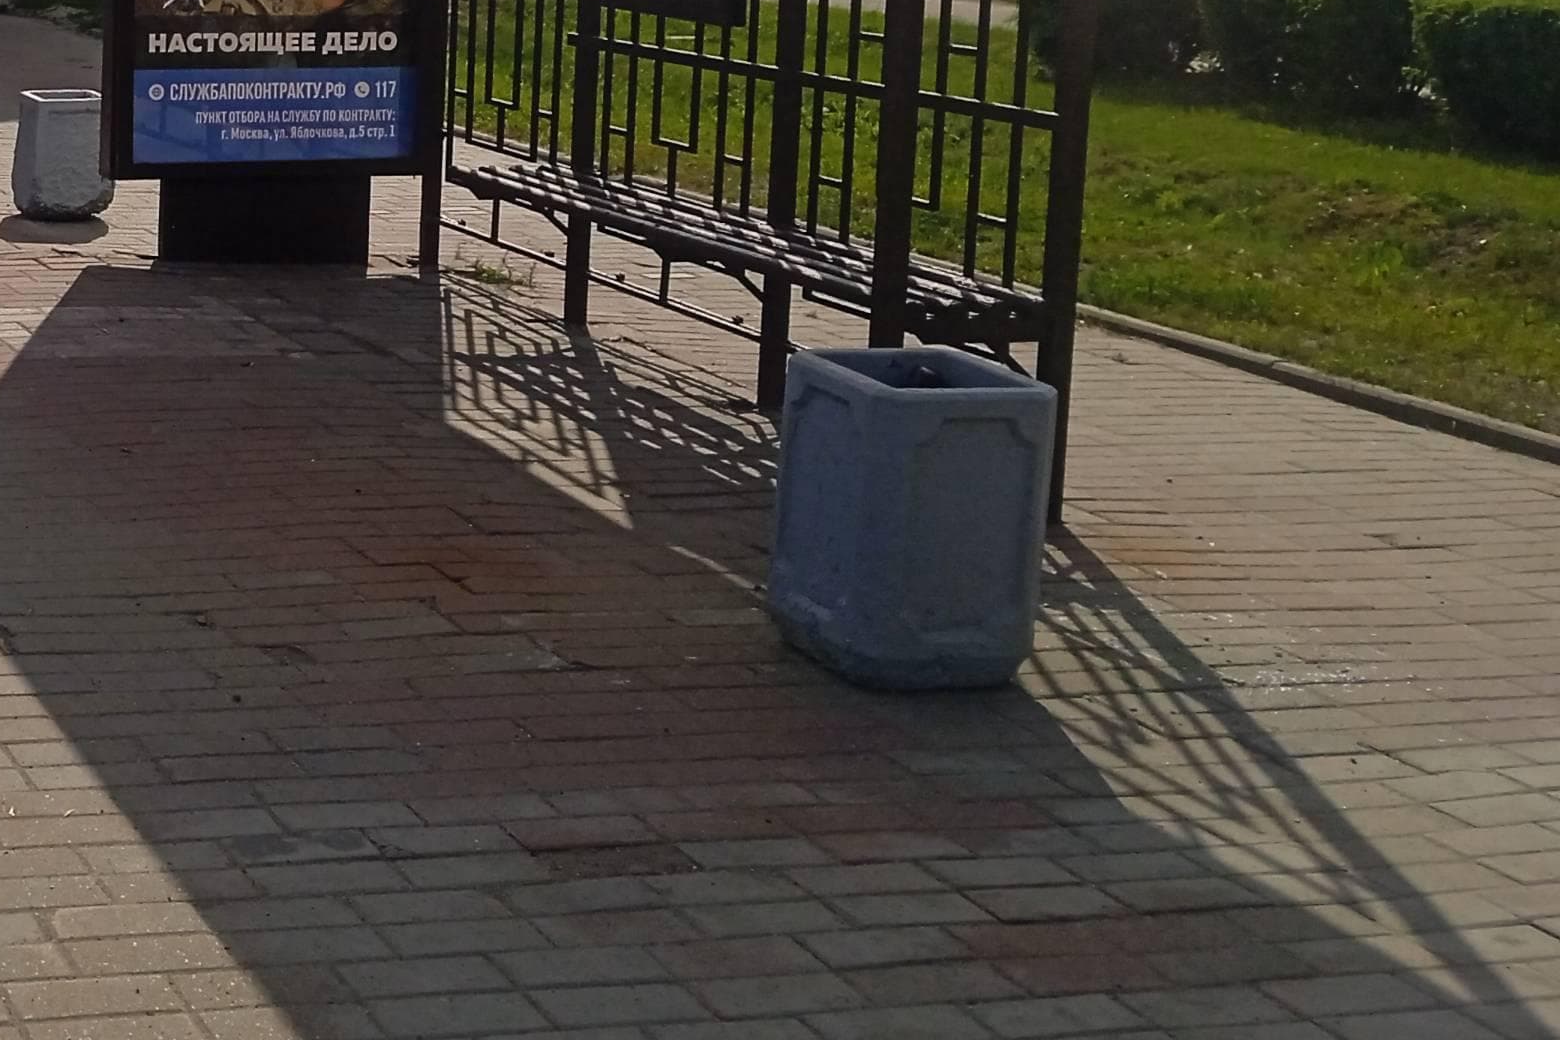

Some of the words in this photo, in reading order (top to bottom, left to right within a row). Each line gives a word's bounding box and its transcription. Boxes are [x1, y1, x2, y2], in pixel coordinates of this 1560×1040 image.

[148, 32, 316, 55] НАСТОЯЩЕЕ
[322, 31, 398, 55] ДЕЛО
[169, 81, 346, 102] СЛУЖБАПОКОНТРАКТУ.РФ
[375, 80, 397, 99] 117
[195, 111, 227, 124] ПУНКТ
[228, 110, 266, 123] ОТБОРА
[267, 110, 280, 122] НА
[281, 109, 321, 122] СЛУЖБУ
[322, 109, 336, 122] ПО
[338, 109, 396, 122] КОНТРАКТУ:
[221, 131, 230, 140] г.
[230, 128, 273, 142] Москва,
[274, 129, 288, 142] ул.
[290, 126, 348, 140] Яблочкова,
[348, 125, 366, 139] д.5
[366, 127, 388, 141] стр.
[389, 125, 396, 138] 1
